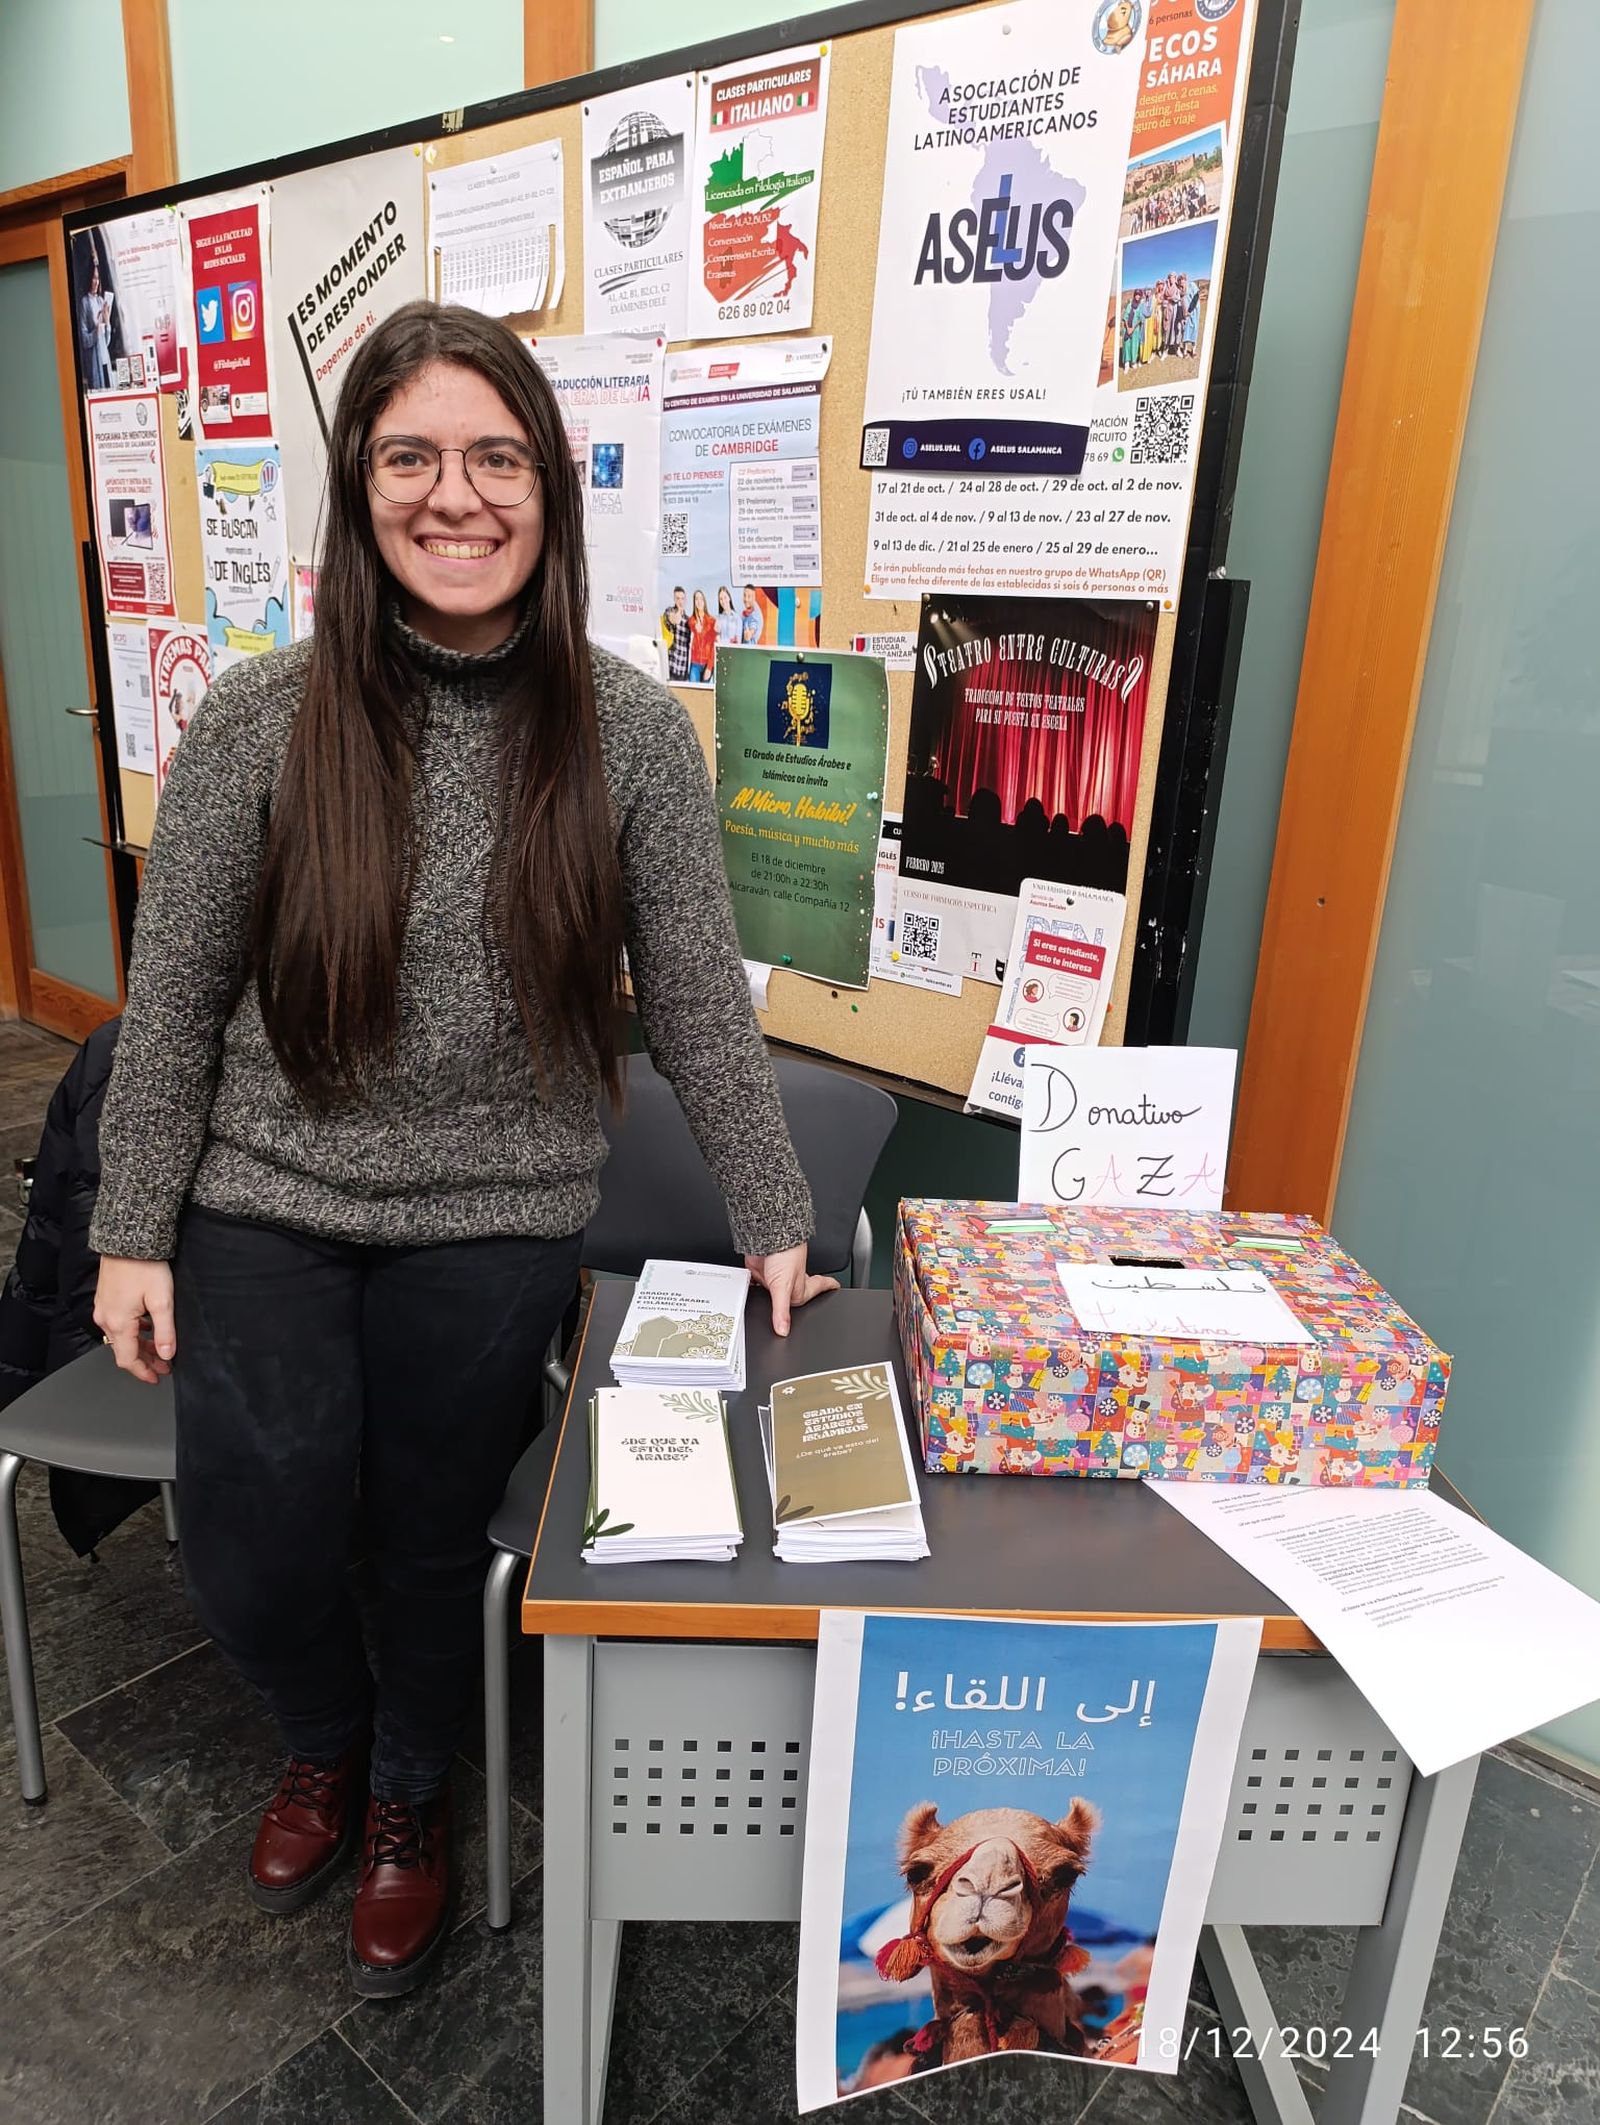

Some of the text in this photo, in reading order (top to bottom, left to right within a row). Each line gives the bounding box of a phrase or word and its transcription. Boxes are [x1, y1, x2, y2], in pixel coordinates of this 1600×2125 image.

[1155, 10, 1193, 26] personas
[1149, 26, 1218, 63] ECOS
[1146, 57, 1222, 88] SÁHARA
[716, 69, 812, 102] CLASES PARTICULARES
[938, 66, 1082, 104] ASOCIACIÓN DE
[1181, 88, 1188, 98] 2
[1188, 84, 1217, 97] cenas
[730, 93, 794, 124] ITALIANO
[948, 92, 1065, 125] ESTUDIANTES
[914, 110, 1098, 151] LATINOAMERICANOS
[598, 150, 675, 184] ESPAÑOL PARA
[600, 172, 675, 204] EXTRANJEROS
[706, 183, 744, 200] Licenciada
[745, 186, 754, 194] en
[786, 175, 811, 186] Italiana
[297, 201, 397, 325] ES MOMENTO
[594, 251, 684, 279] CLASES PARTICULARES
[306, 233, 407, 354] DE RESPONDER
[718, 299, 790, 320] 626 89 02 04
[315, 310, 377, 382] Depende de ti.
[902, 386, 1046, 403] ¡TÚ TAMBIÉN ERES USAL!
[669, 418, 812, 442] CONVOCATORIA DE EXÁMENES
[696, 440, 778, 457] DE CAMBRIDGE
[920, 444, 960, 453] ASELUS.USAL
[991, 445, 1062, 455] ASELUS SALAMANCA
[878, 483, 888, 494] 17
[889, 483, 898, 494] al
[901, 483, 911, 494] 21
[913, 482, 924, 494] de
[928, 484, 945, 494] oct.
[960, 482, 972, 492] 24
[976, 481, 985, 492] al
[988, 481, 1001, 492] 28
[1004, 480, 1017, 492] de
[1020, 481, 1039, 492] oct.
[1052, 480, 1068, 491] 29
[1070, 479, 1084, 491] de
[1088, 480, 1108, 491] oct.
[1112, 478, 1122, 490] al
[1127, 478, 1134, 490] 2
[1138, 478, 1152, 490] de
[1156, 480, 1182, 490] nov.
[207, 518, 258, 539] SE BUSCAN
[214, 552, 271, 584] DE INGLÉS
[874, 562, 882, 572] Se
[884, 562, 900, 572] irán
[902, 564, 946, 576] publicando
[948, 565, 965, 574] más
[967, 565, 994, 575] fechas
[1008, 568, 1042, 576] nuestro
[1045, 569, 1072, 578] grupo
[1076, 567, 1086, 577] de
[1088, 568, 1140, 580] WhatsApp
[1143, 568, 1166, 581] (QR)
[872, 636, 907, 644] ESTUDIAR,
[938, 634, 1124, 690] TEATRO ENTRE CULTURAS
[1005, 691, 1014, 706] DE
[1016, 692, 1042, 708] TEXTOS
[1045, 694, 1085, 712] TEATRALES
[976, 708, 992, 723] PARA
[1004, 710, 1028, 727] PUESTA
[1031, 713, 1040, 728] EN
[1042, 714, 1068, 730] ESCENA
[744, 748, 852, 770] El Grado de Estudios Árabes e
[762, 769, 828, 787] Islámicos os invita
[730, 787, 754, 809] Al
[750, 789, 792, 819] Micro,
[726, 819, 860, 854] Poesía, música y mucho más
[752, 852, 826, 874] El 18 de diciembre
[906, 856, 930, 872] FEBRERO
[751, 869, 828, 892] de 21:00h a 22:30h
[774, 889, 792, 901] calle
[794, 892, 836, 910] Compañía
[840, 902, 850, 912] 12
[1033, 938, 1100, 962] Si eres estudiante,
[1036, 954, 1092, 973] esto te interesa
[1028, 1063, 1202, 1132] Donativo
[1051, 1147, 1221, 1201] GAZA
[1091, 1275, 1266, 1294] فلسطين
[803, 1402, 864, 1418] GRADO EN
[804, 1410, 864, 1426] ESTUDIOS
[856, 1416, 865, 1424] E
[895, 1671, 1156, 1727] إلى اللقاء!
[931, 1729, 1095, 1750] ¡HASTA LA
[932, 1752, 1088, 1776] PRÓXIMA!
